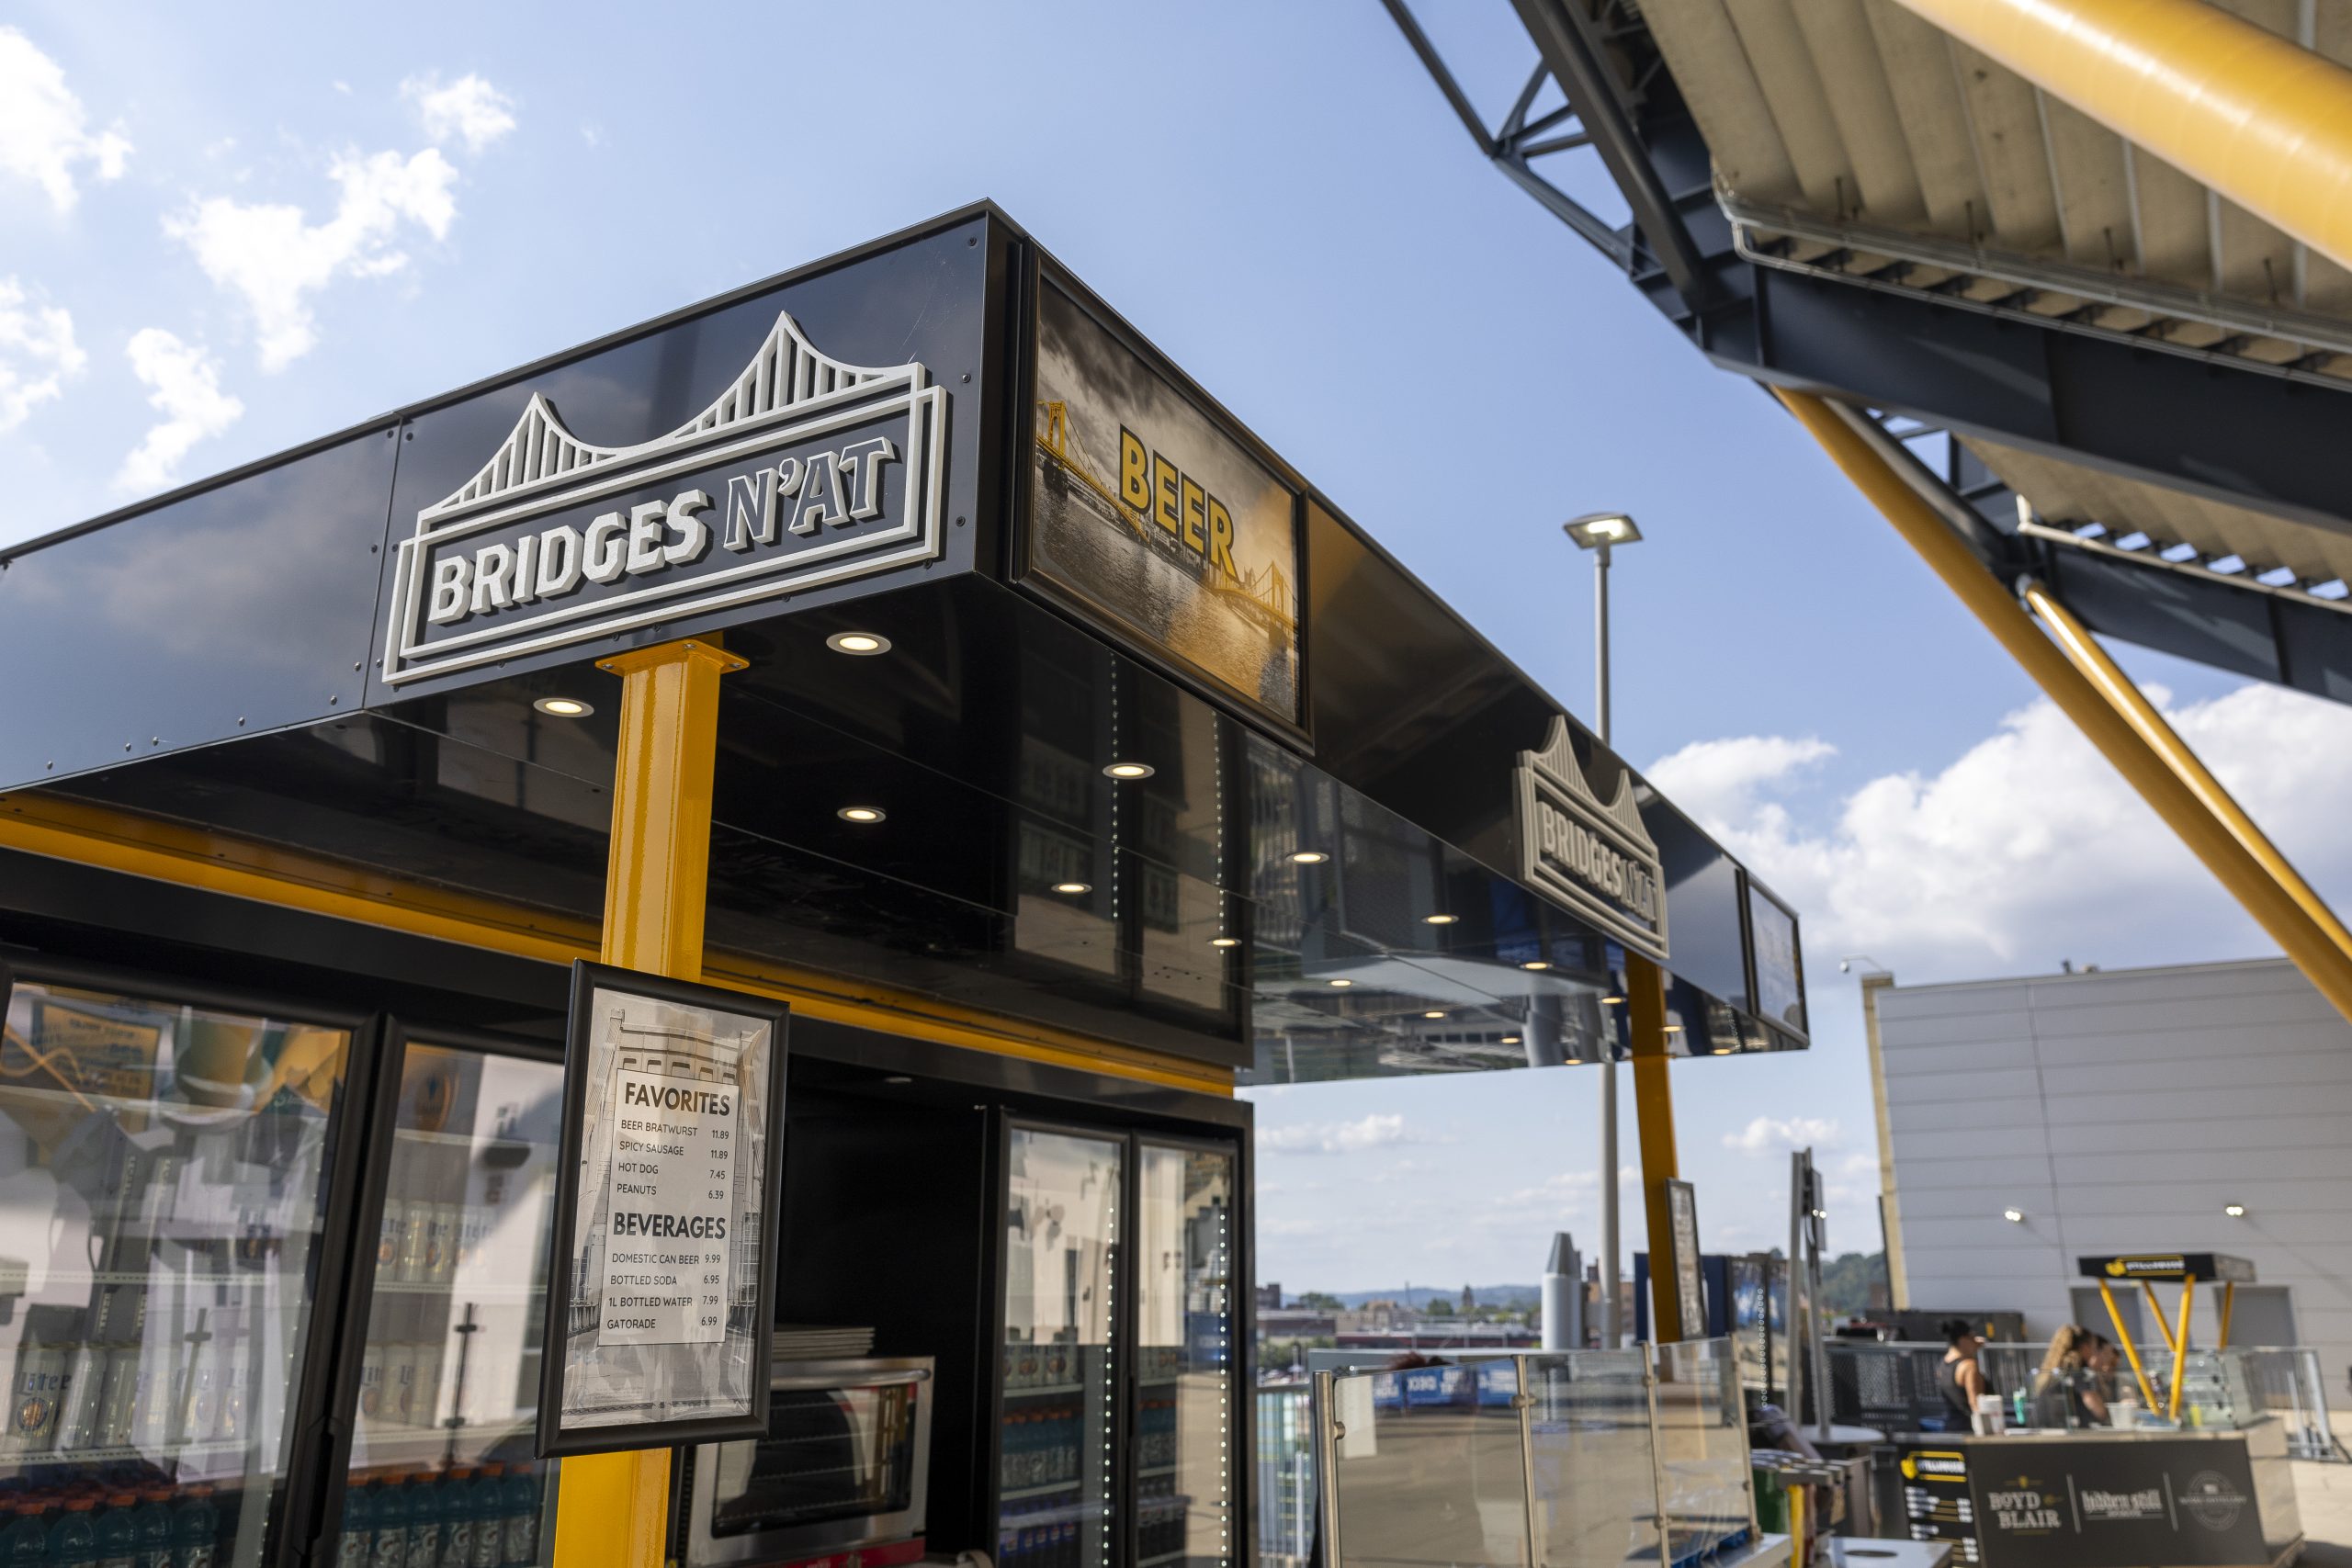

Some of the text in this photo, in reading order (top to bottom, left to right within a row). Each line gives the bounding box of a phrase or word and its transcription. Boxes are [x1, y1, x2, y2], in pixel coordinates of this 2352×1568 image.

[1119, 423, 1241, 585] BEER
[428, 488, 709, 625] BRIDGES
[1536, 801, 1622, 897] BRIDGES
[625, 1082, 730, 1116] FAVORITES
[621, 1120, 729, 1139] BEER BRATWURST 11.89
[619, 1141, 729, 1159] SPICY SAUSAGE 11.89
[618, 1162, 726, 1179] HOT DOG 7.45
[616, 1183, 724, 1200] PEANUTS 6.39
[613, 1212, 726, 1239] BEVERAGES
[612, 1253, 721, 1265] DOMESTIC CAN BEER 9.99
[610, 1275, 719, 1285] BOTTLED SODA 6.95
[608, 1296, 718, 1307] 1L BOTTLED WATER 7.99
[607, 1316, 718, 1329] GATORADE 6.99
[1987, 1491, 2041, 1511] BOYD
[1996, 1509, 2063, 1529] BLAIR
